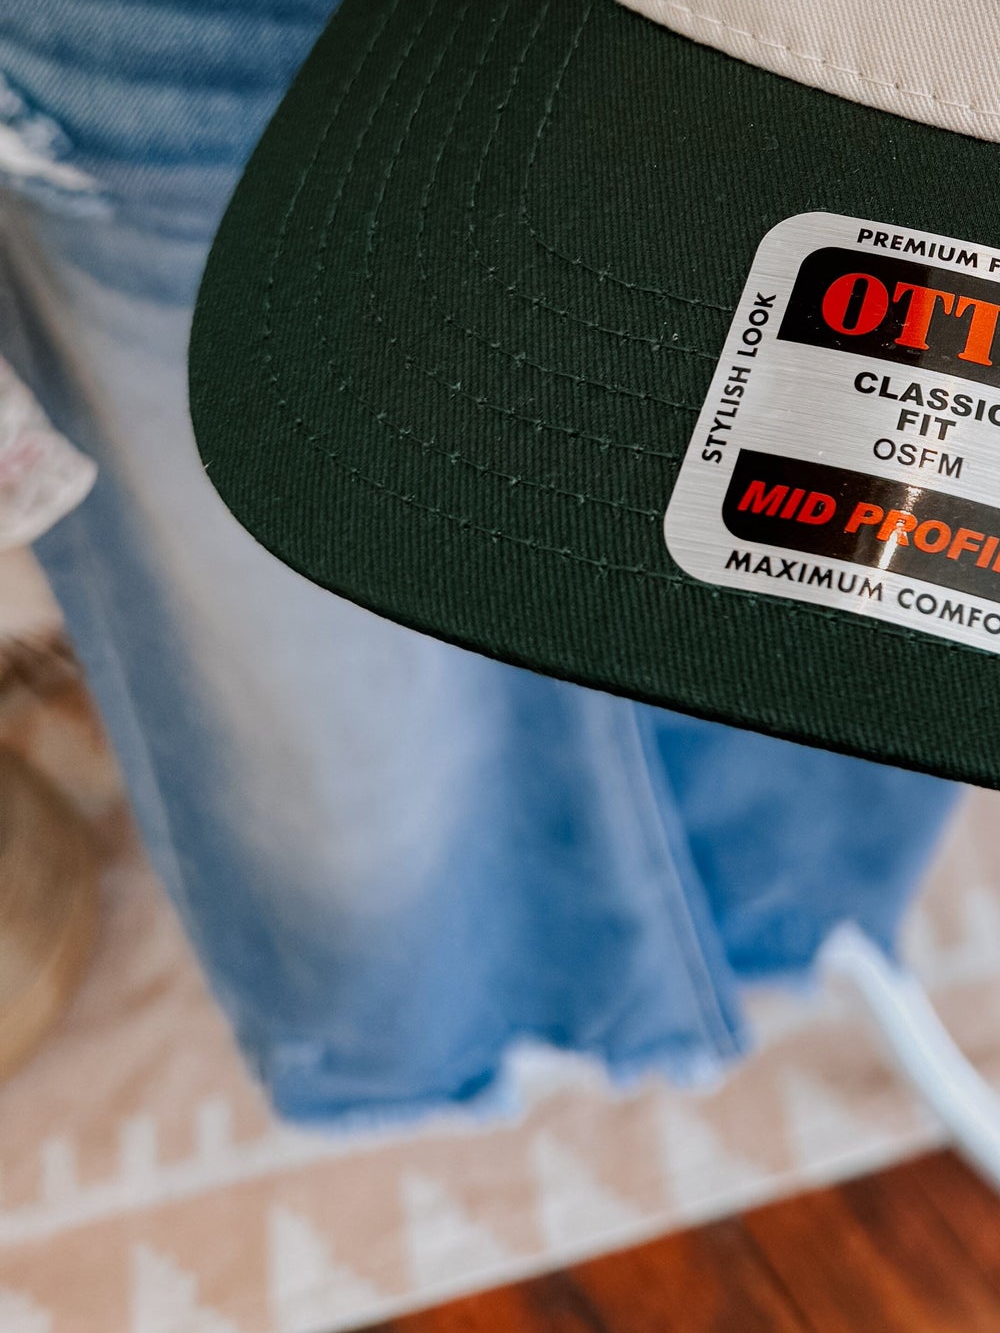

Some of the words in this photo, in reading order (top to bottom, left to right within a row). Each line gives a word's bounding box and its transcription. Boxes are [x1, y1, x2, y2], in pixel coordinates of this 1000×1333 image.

[856, 228, 979, 269] PREMIUM
[701, 365, 752, 464] STYLISH
[737, 291, 778, 358] LOOK
[896, 409, 957, 441] FIT
[872, 437, 965, 479] OSFM
[736, 480, 837, 526] MID
[724, 550, 885, 602] MAXIMUM
